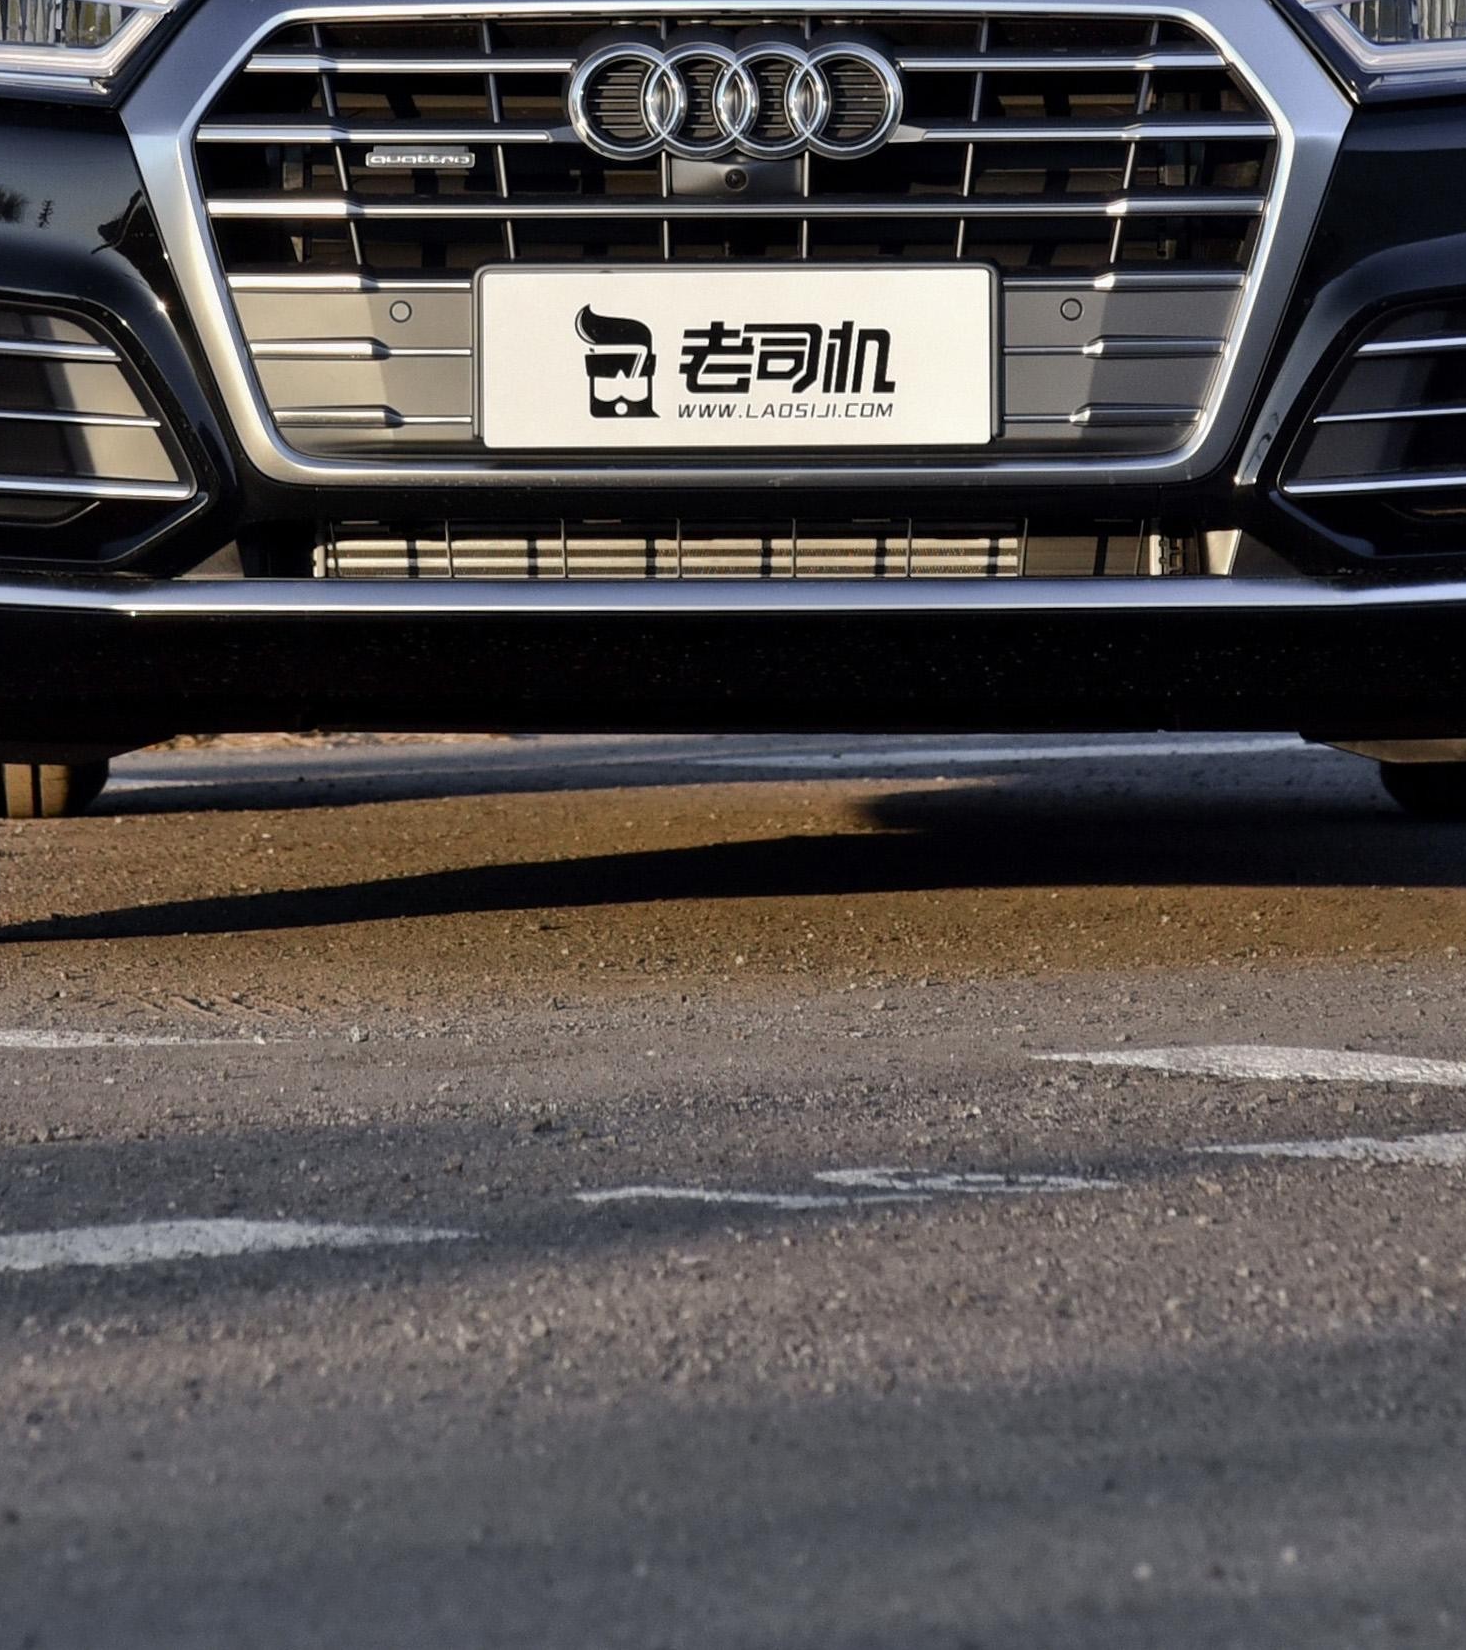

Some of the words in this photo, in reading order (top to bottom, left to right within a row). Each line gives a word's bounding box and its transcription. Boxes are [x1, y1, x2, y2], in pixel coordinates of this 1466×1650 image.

[369, 153, 472, 166] quattro
[678, 320, 897, 394] 老司机
[677, 402, 894, 419] WWW.LAOSIJI.COM
